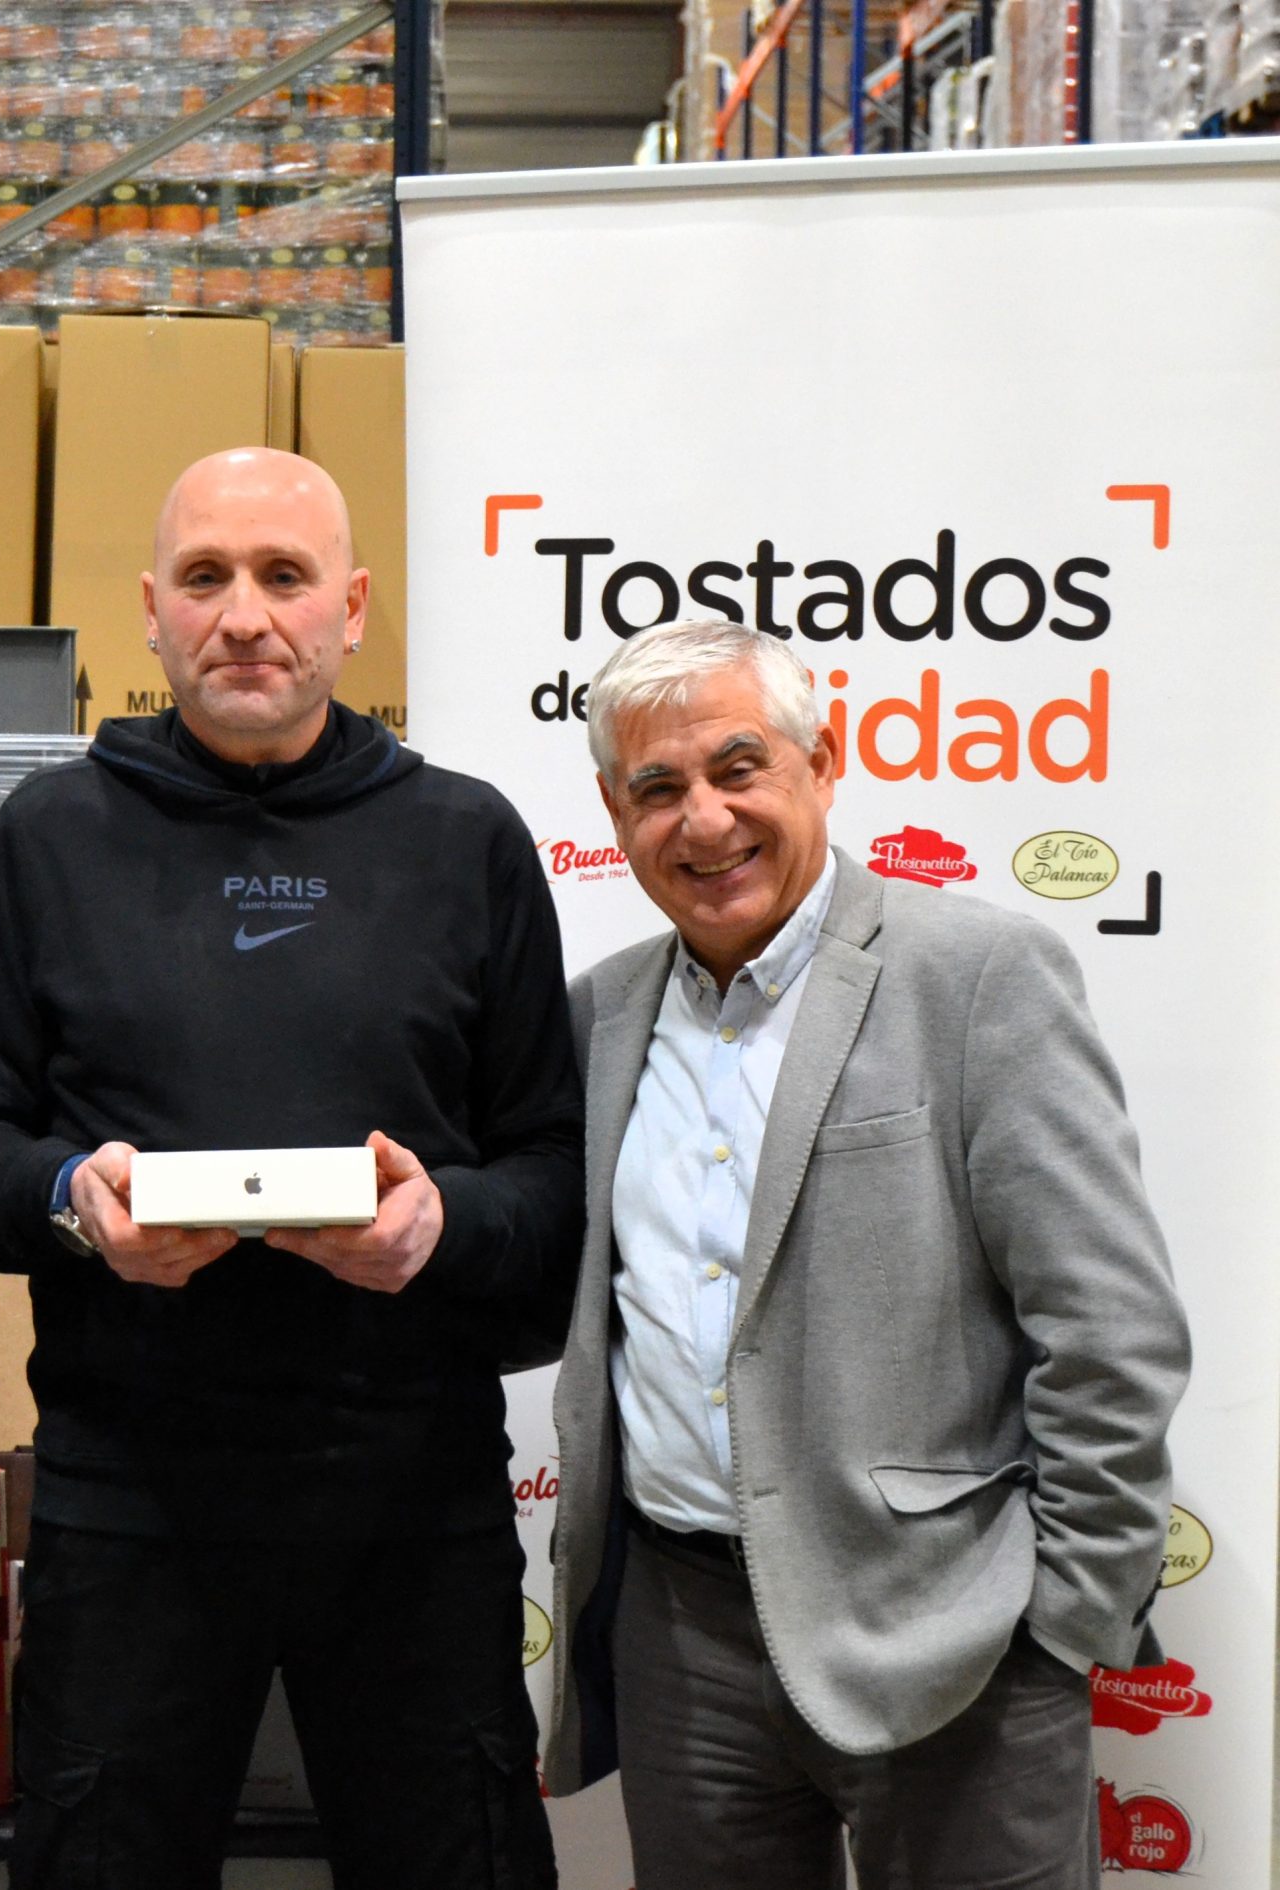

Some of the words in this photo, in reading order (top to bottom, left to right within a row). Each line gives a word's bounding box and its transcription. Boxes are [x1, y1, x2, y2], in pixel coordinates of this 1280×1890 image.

[534, 529, 1112, 642] Tostados
[370, 705, 407, 728] MU
[810, 668, 1110, 784] idad
[1034, 839, 1060, 860] El
[1062, 839, 1099, 861] Tío
[876, 841, 968, 882] Pasionatta
[578, 871, 605, 881] Desde
[608, 869, 629, 879] 1964
[1023, 862, 1109, 884] Palancas
[224, 876, 328, 898] PARIS
[238, 902, 314, 911] SAINT-GERMAIN
[1131, 1823, 1175, 1843] gallo
[1129, 1842, 1166, 1863] rojo
